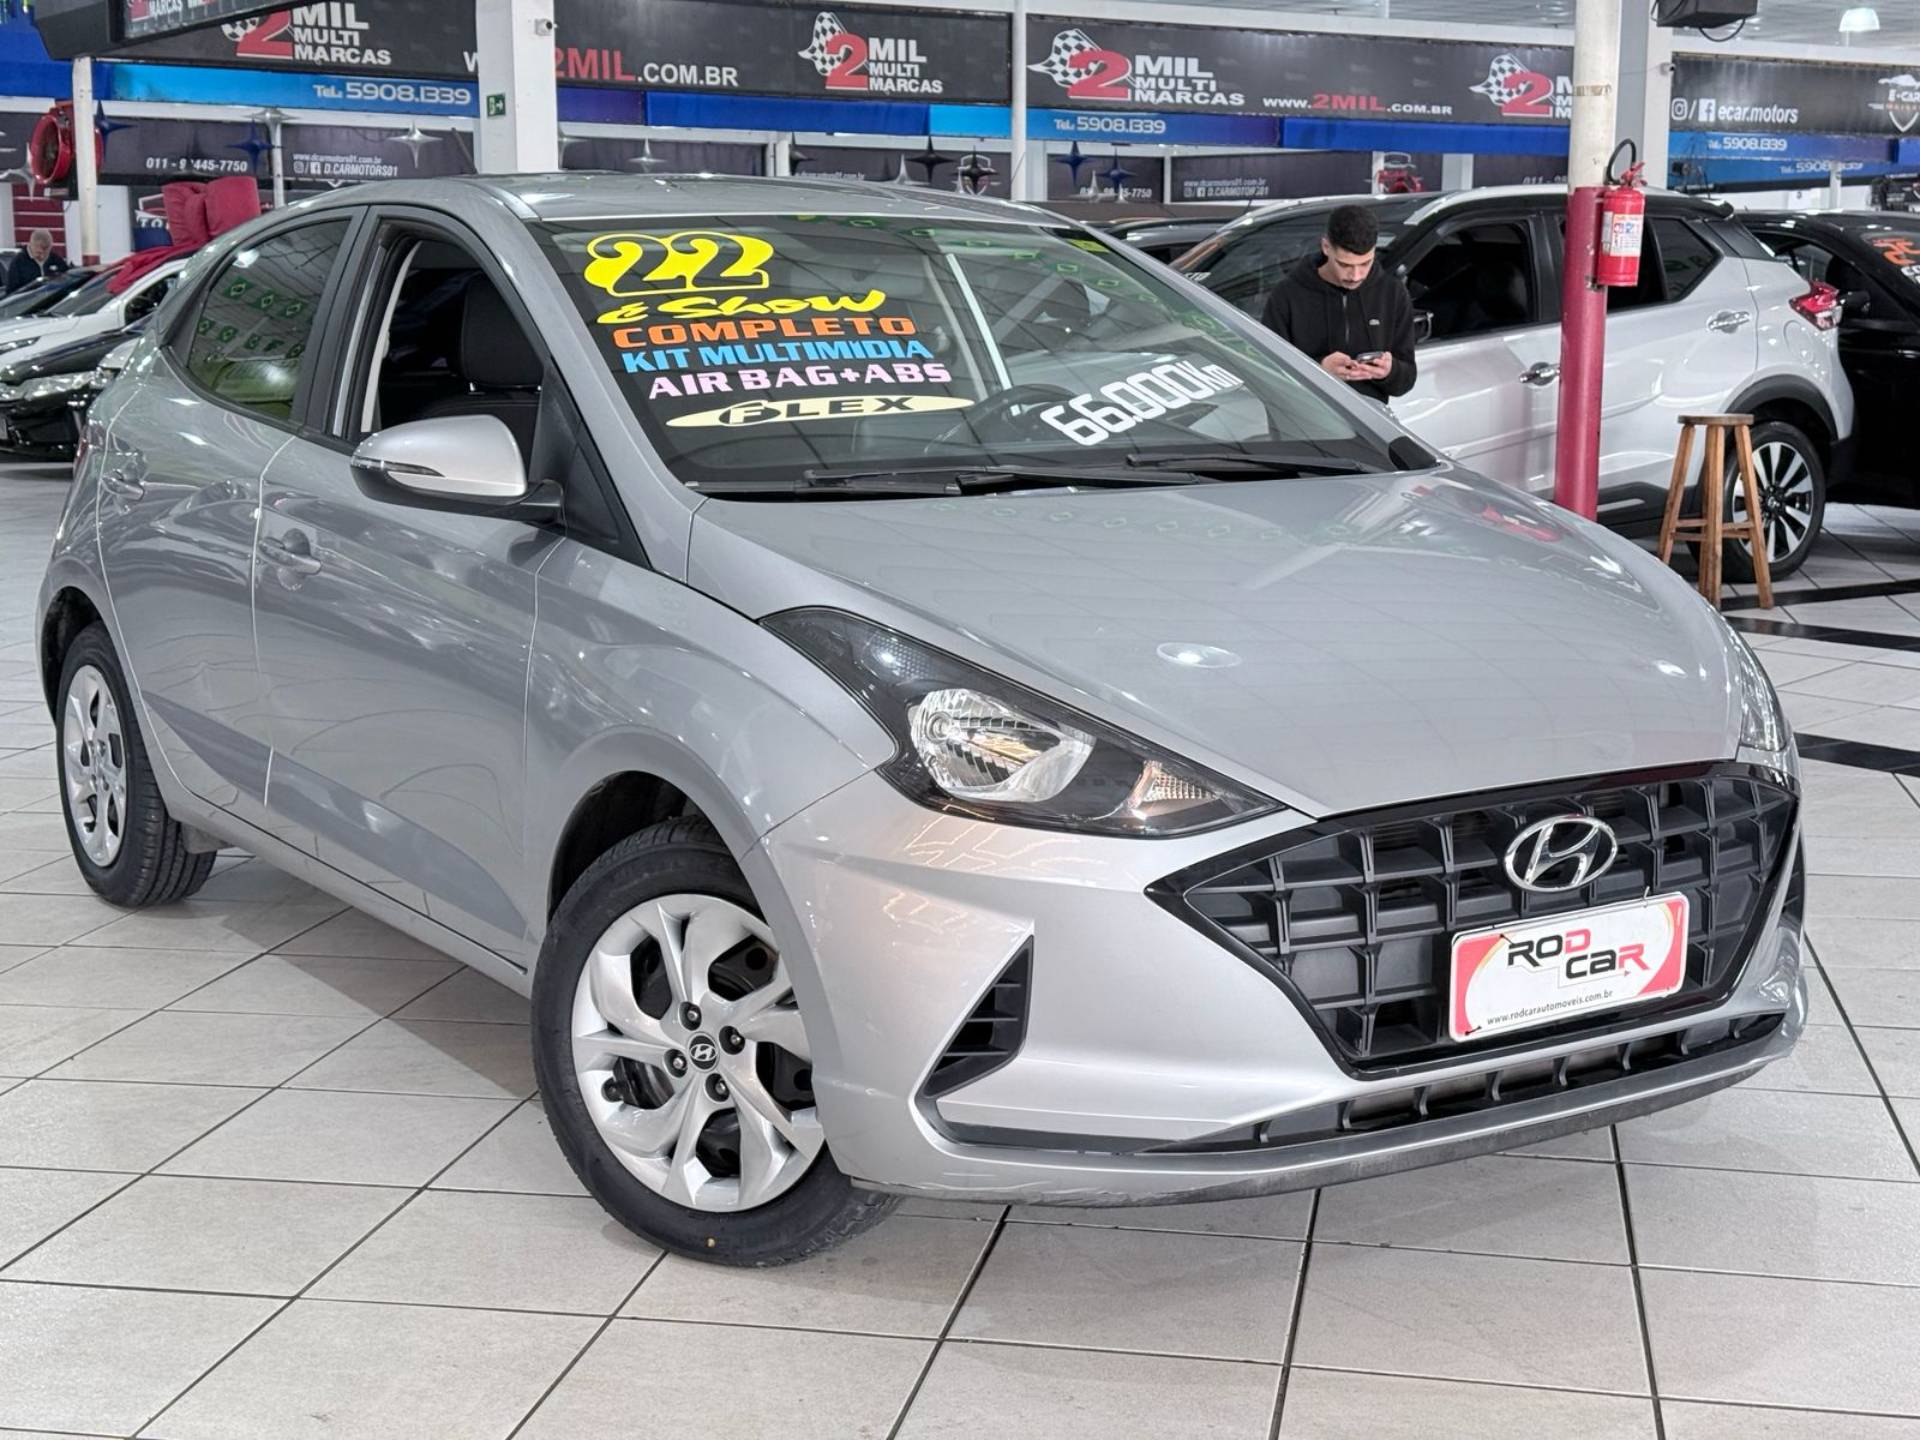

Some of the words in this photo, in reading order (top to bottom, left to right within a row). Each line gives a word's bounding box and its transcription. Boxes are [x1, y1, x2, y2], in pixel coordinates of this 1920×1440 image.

[293, 2, 369, 30] MIL
[294, 27, 361, 46] MULTI
[294, 45, 392, 66] MARCAS
[868, 37, 927, 64] MIL
[868, 62, 921, 78] MULTI
[1135, 55, 1214, 78] MIL
[345, 82, 472, 105] 5908.1339
[868, 77, 944, 94] MARCAS
[1135, 77, 1217, 92] MULTI
[1135, 89, 1245, 106] MARCAS
[1717, 104, 1799, 124] ecar.motors
[146, 157, 168, 169] 011
[179, 158, 248, 172] 9445-7750
[583, 230, 775, 297] 22
[657, 290, 887, 320] Show
[612, 316, 917, 349] COMPLETO
[621, 348, 690, 375] KIT
[648, 372, 734, 400] AIR
[737, 362, 953, 391] BAG+ABS
[722, 396, 915, 425] FLEX
[1507, 928, 1592, 967] ROD
[1487, 989, 1613, 1026] www.rodcarautomoveis.com.br
